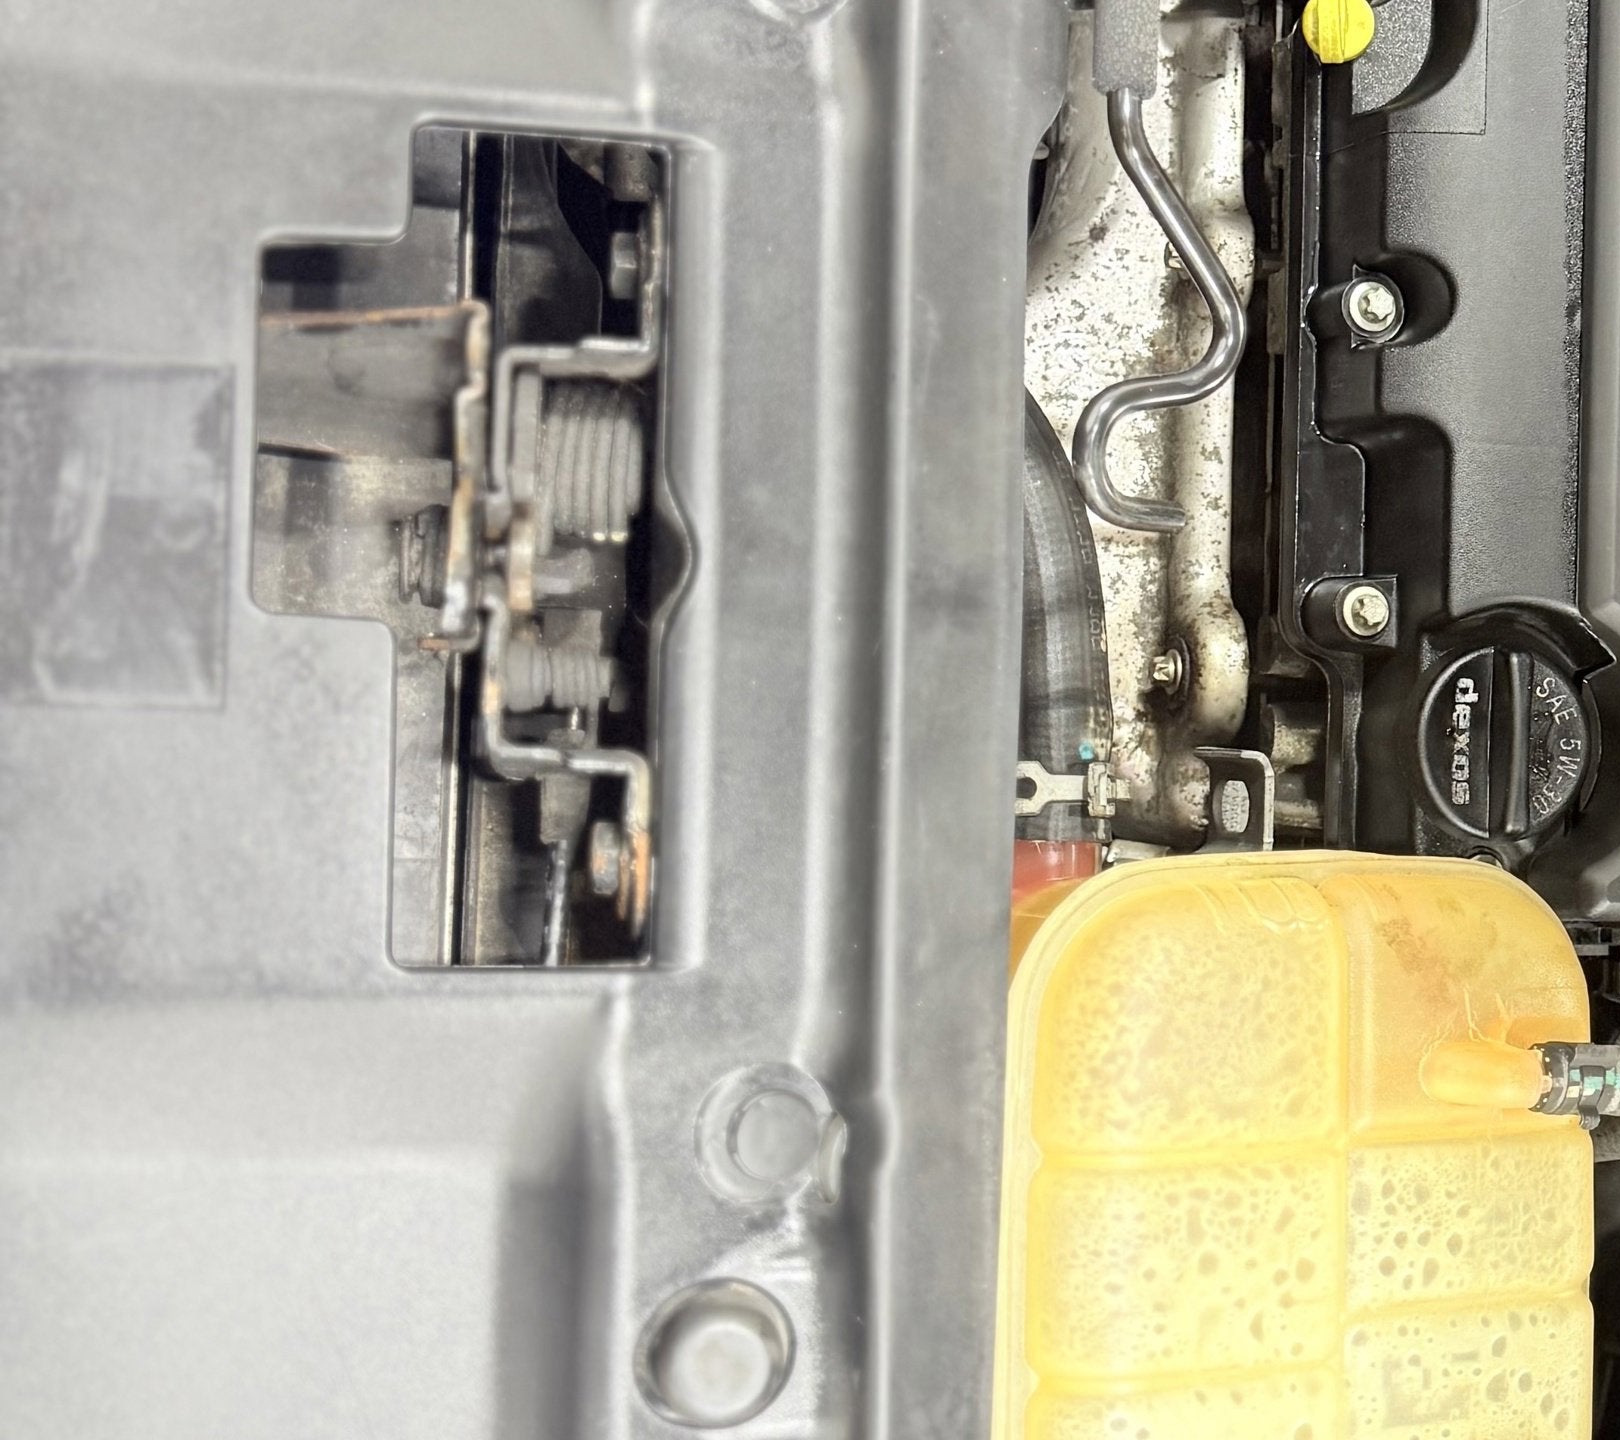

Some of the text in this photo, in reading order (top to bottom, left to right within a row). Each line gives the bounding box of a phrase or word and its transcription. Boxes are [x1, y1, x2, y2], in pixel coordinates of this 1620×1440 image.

[1450, 677, 1479, 806] dexos
[1532, 676, 1583, 816] SAE 5W-30
